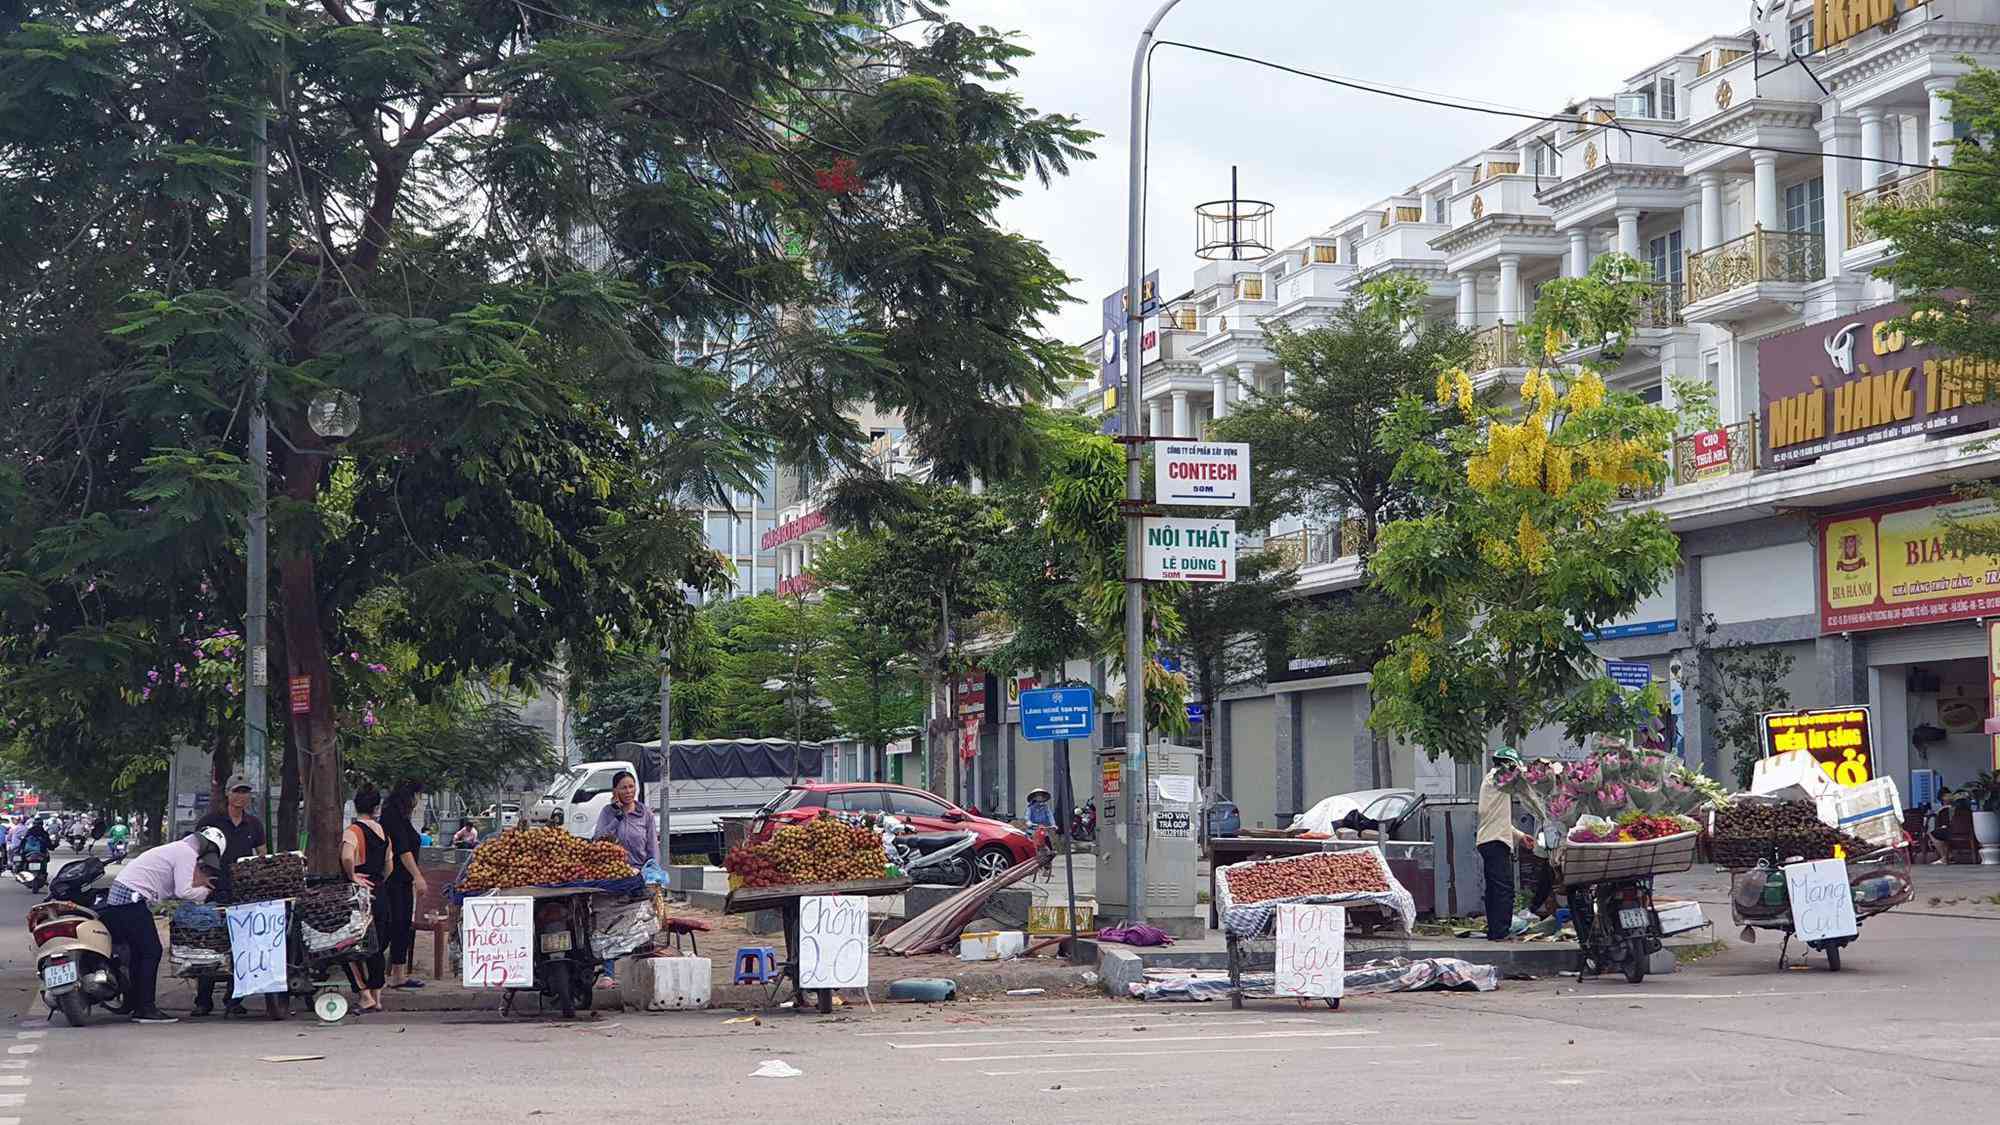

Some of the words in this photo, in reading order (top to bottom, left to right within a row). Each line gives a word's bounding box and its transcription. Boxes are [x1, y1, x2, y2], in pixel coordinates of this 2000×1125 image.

[1769, 376, 1825, 449] NHÀ
[1834, 363, 1914, 434] HÀNG
[1703, 433, 1719, 447] CHO
[1181, 447, 1188, 455] TY
[1169, 462, 1237, 480] CONTECH
[1193, 485, 1214, 493] 50M
[1148, 525, 1180, 551] NỘI
[1185, 523, 1230, 548] THẤT
[1905, 537, 1943, 566] BIA
[1162, 555, 1177, 569] LÊ
[1832, 586, 1846, 600] BIA
[801, 935, 863, 985] 20
